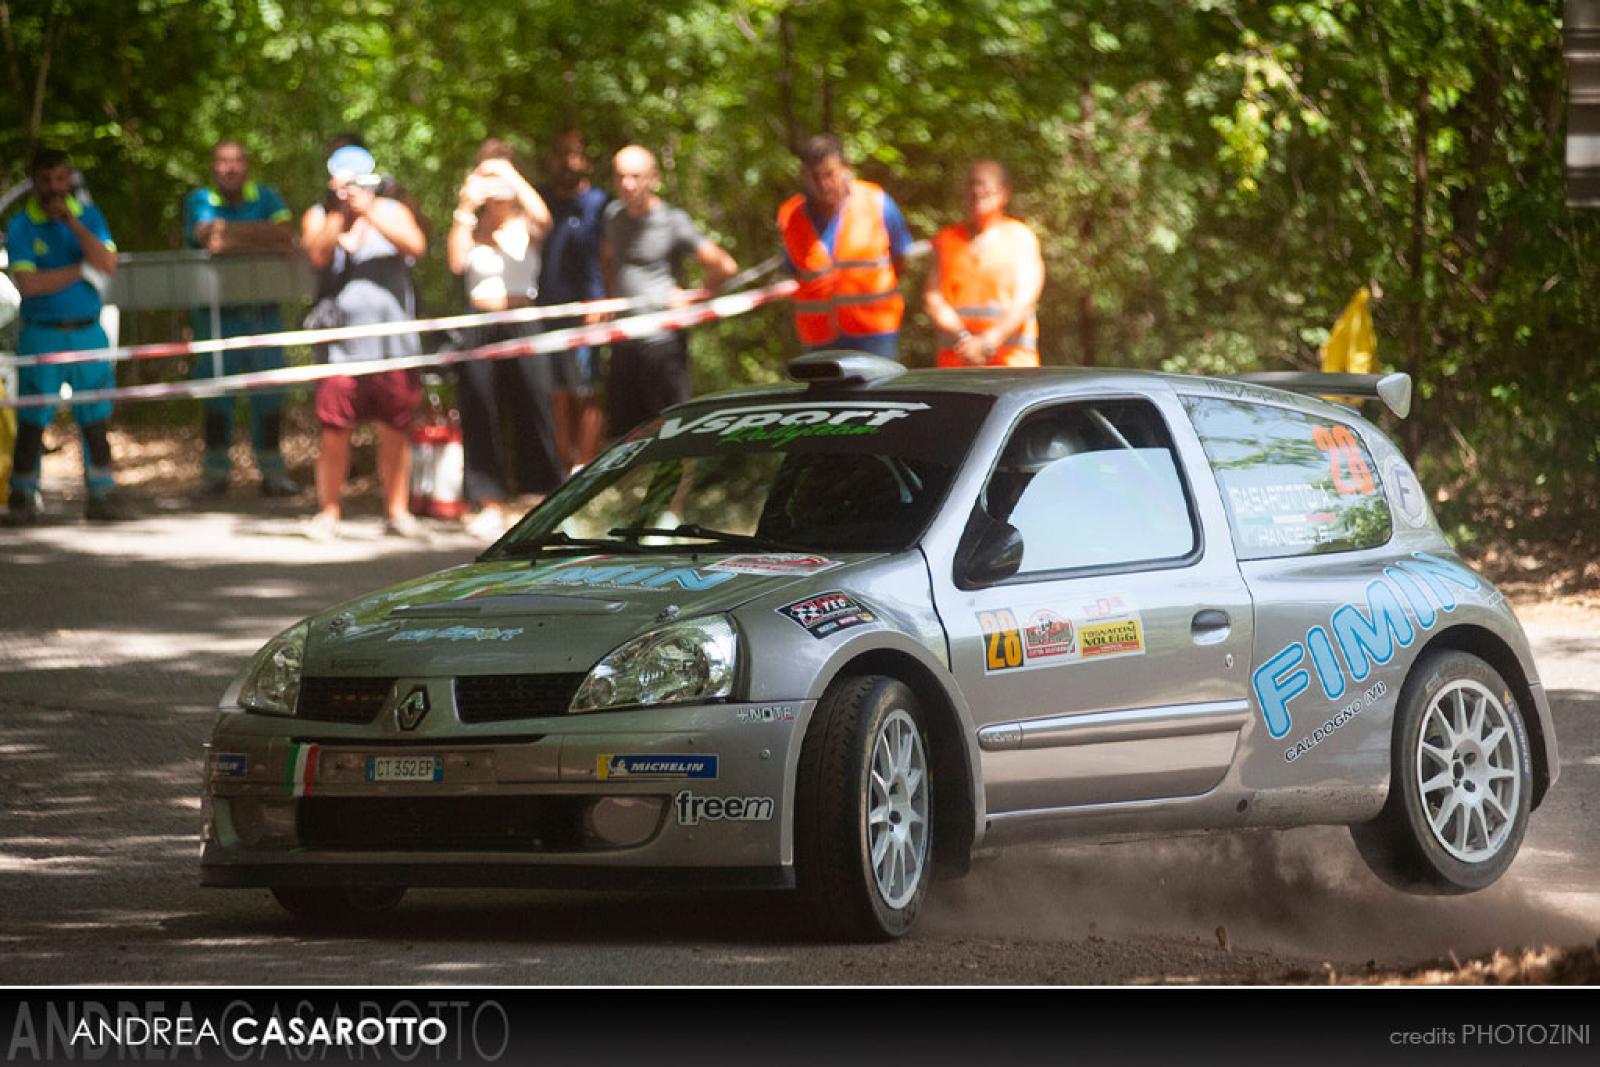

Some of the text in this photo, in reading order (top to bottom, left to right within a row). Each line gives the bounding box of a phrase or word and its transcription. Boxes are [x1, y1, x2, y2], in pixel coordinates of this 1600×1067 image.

[1311, 425, 1377, 495] 28
[979, 609, 1022, 669] 28
[1253, 552, 1480, 740] FIMIN
[1284, 698, 1363, 763] CALDOGNO
[395, 760, 416, 776] 352
[631, 761, 704, 772] MICHELIN
[677, 792, 774, 824] freem
